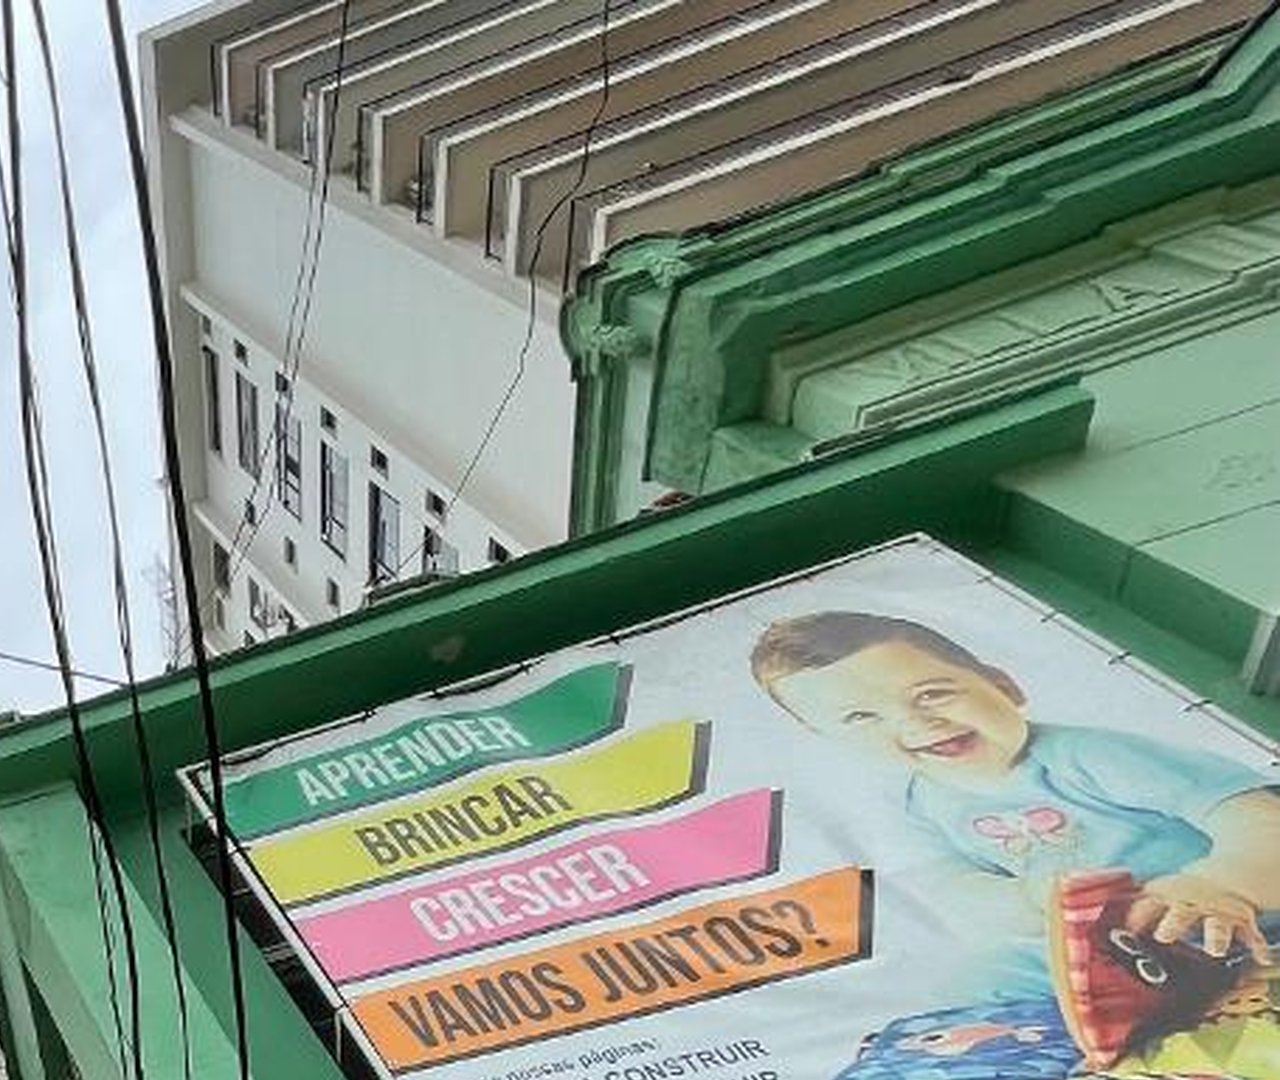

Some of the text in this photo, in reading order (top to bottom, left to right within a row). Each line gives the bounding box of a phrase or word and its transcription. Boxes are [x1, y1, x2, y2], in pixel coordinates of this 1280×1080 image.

[296, 715, 532, 807] APRENDER
[354, 774, 574, 867] BRINCAR
[408, 843, 651, 944] CRESCER
[388, 898, 831, 1049] VAMOS JUNTOS?
